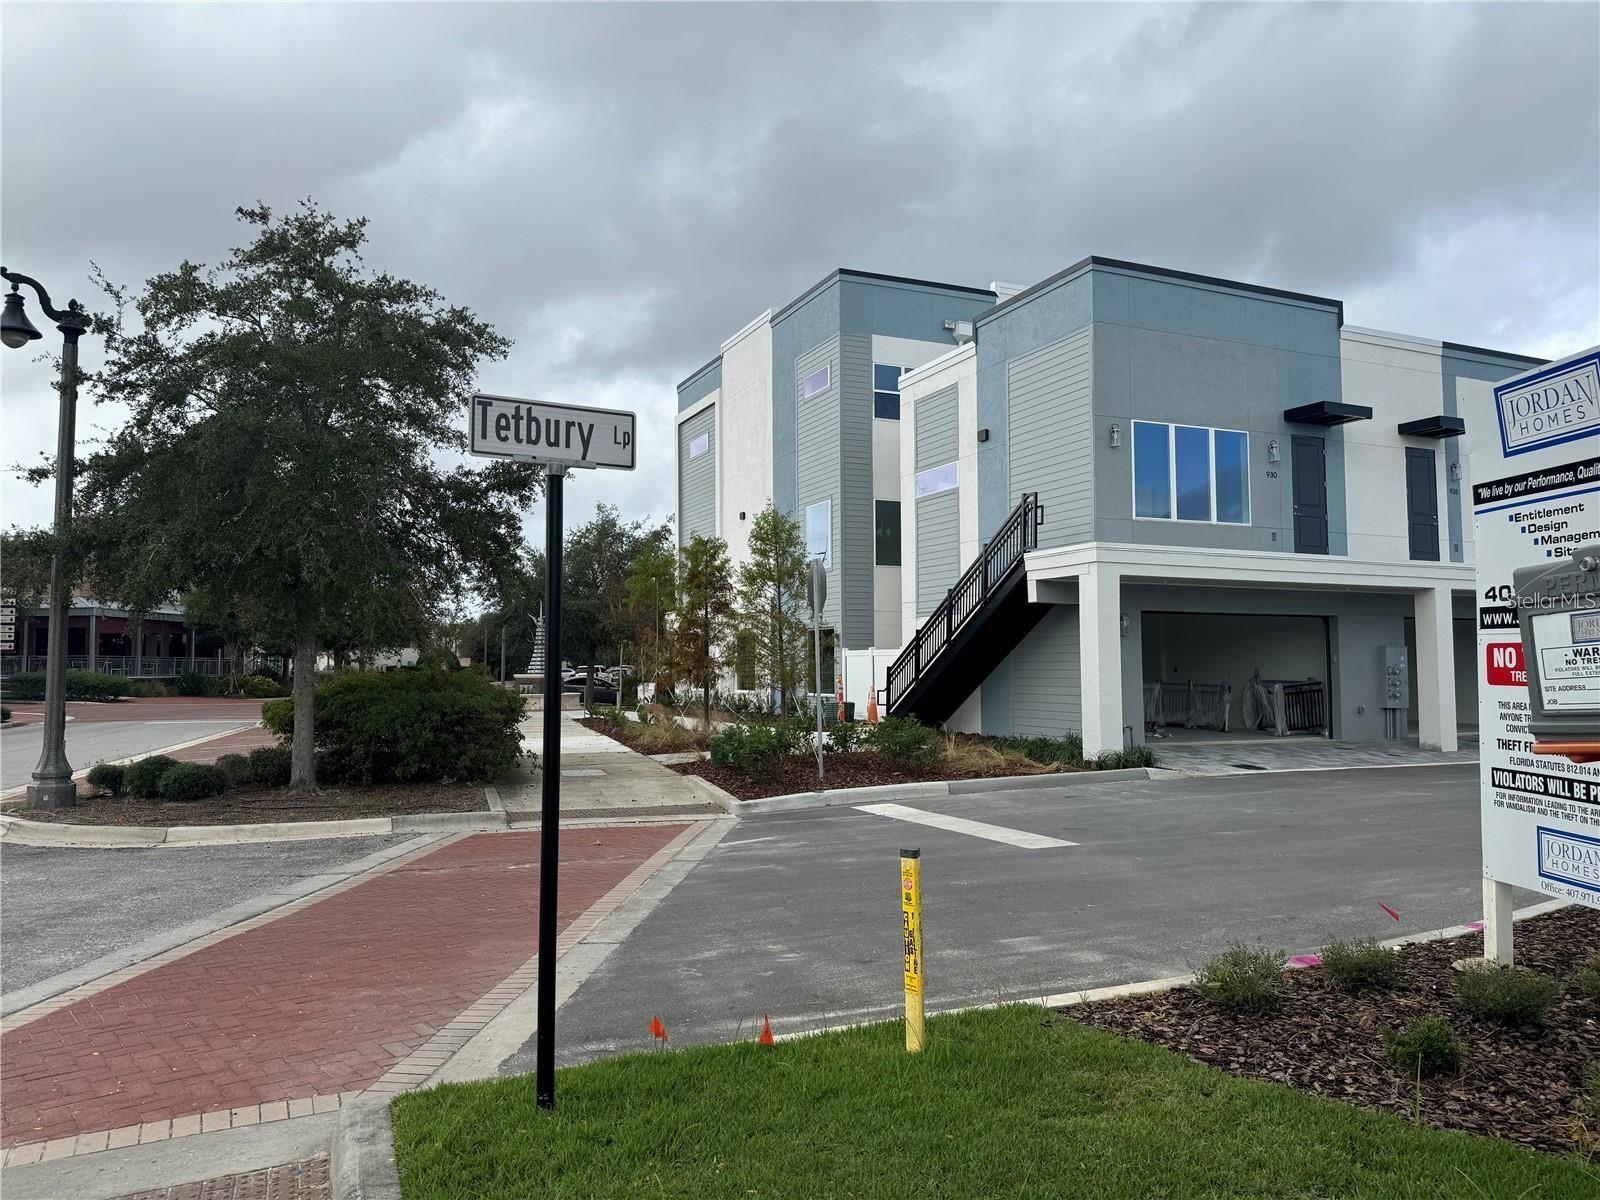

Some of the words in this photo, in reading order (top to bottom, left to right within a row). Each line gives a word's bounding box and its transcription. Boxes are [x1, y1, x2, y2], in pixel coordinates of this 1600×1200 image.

[1508, 374, 1594, 429] JORDAN
[1519, 404, 1586, 436] HOMES
[476, 400, 595, 461] Tetbury
[613, 425, 631, 450] Lp
[1265, 471, 1278, 479] 930
[1491, 485, 1503, 496] live
[1504, 483, 1513, 496] by
[1514, 481, 1526, 492] our
[1527, 471, 1575, 490] Performance,
[1514, 503, 1585, 523] Entitlement
[1528, 521, 1568, 533] Design
[1484, 585, 1514, 602] 40
[1493, 647, 1517, 668] NO
[1565, 658, 1578, 666] NO
[1498, 701, 1511, 710] THIS
[1512, 702, 1528, 711] AREA
[1500, 712, 1523, 722] ANYONE
[1505, 724, 1529, 734] CONVIC
[1496, 738, 1522, 752] THEFT
[1509, 756, 1535, 768] FLORIDA
[1536, 760, 1566, 773] STATUTES
[1566, 763, 1591, 776] 812.014
[1493, 770, 1545, 793] VIOLATORS
[1547, 777, 1571, 797] WILL
[1573, 782, 1587, 800] BE
[1493, 799, 1504, 808] FOR
[1505, 801, 1536, 814] VANDALISM
[1537, 808, 1548, 816] AND
[1549, 809, 1560, 819] THE
[1561, 811, 1578, 822] THEFT
[1580, 815, 1589, 824] ON
[1495, 791, 1507, 800] FOR
[1507, 793, 1543, 806] INFORMATION
[1544, 799, 1567, 810] LEADING
[1568, 803, 1576, 813] TO
[1577, 804, 1588, 815] THE
[1551, 858, 1600, 880] HOMES
